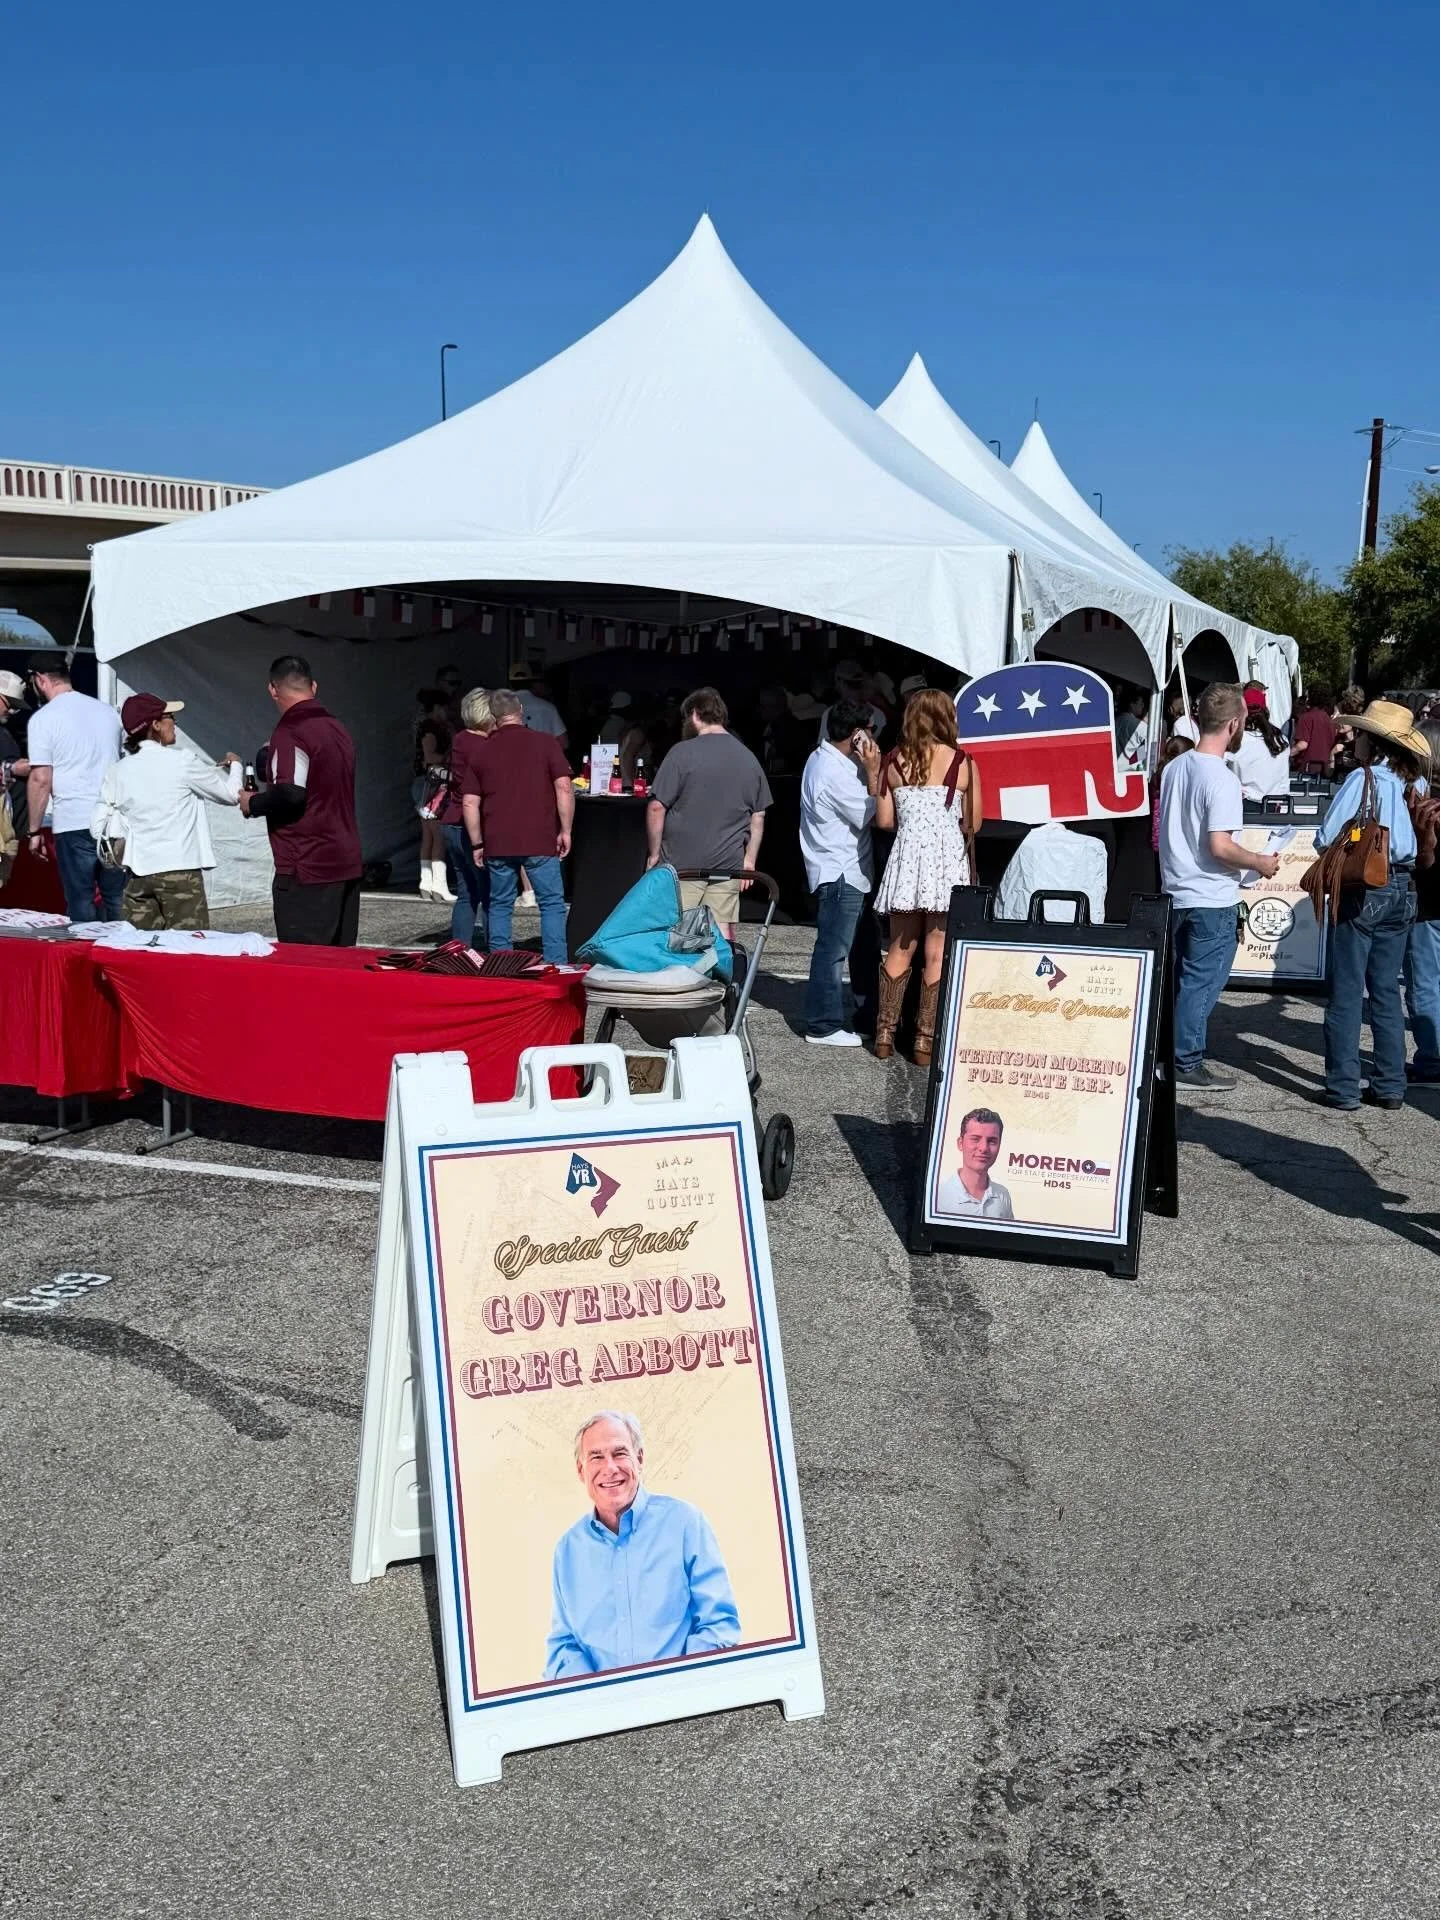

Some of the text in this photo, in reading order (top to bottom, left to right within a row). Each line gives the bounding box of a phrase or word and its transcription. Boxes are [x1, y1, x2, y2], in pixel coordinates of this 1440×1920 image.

[1247, 943, 1271, 951] Print
[1259, 951, 1284, 960] Pixel
[966, 991, 1131, 1021] Bald Eagle Sponsor
[958, 1049, 1127, 1076] TENNYSON MORENO
[967, 1067, 1114, 1094] FOR STATE REP.
[1008, 1152, 1097, 1174] MORENO
[572, 1169, 591, 1185] YR
[1024, 1170, 1046, 1178] STATE
[1047, 1172, 1110, 1184] REPRESENTATIVE
[1043, 1179, 1072, 1190] HD45
[494, 1228, 611, 1280] Special
[609, 1221, 699, 1267] Guest
[482, 1272, 726, 1335] GOVERNOR
[460, 1327, 755, 1400] GREG ABBOTT
